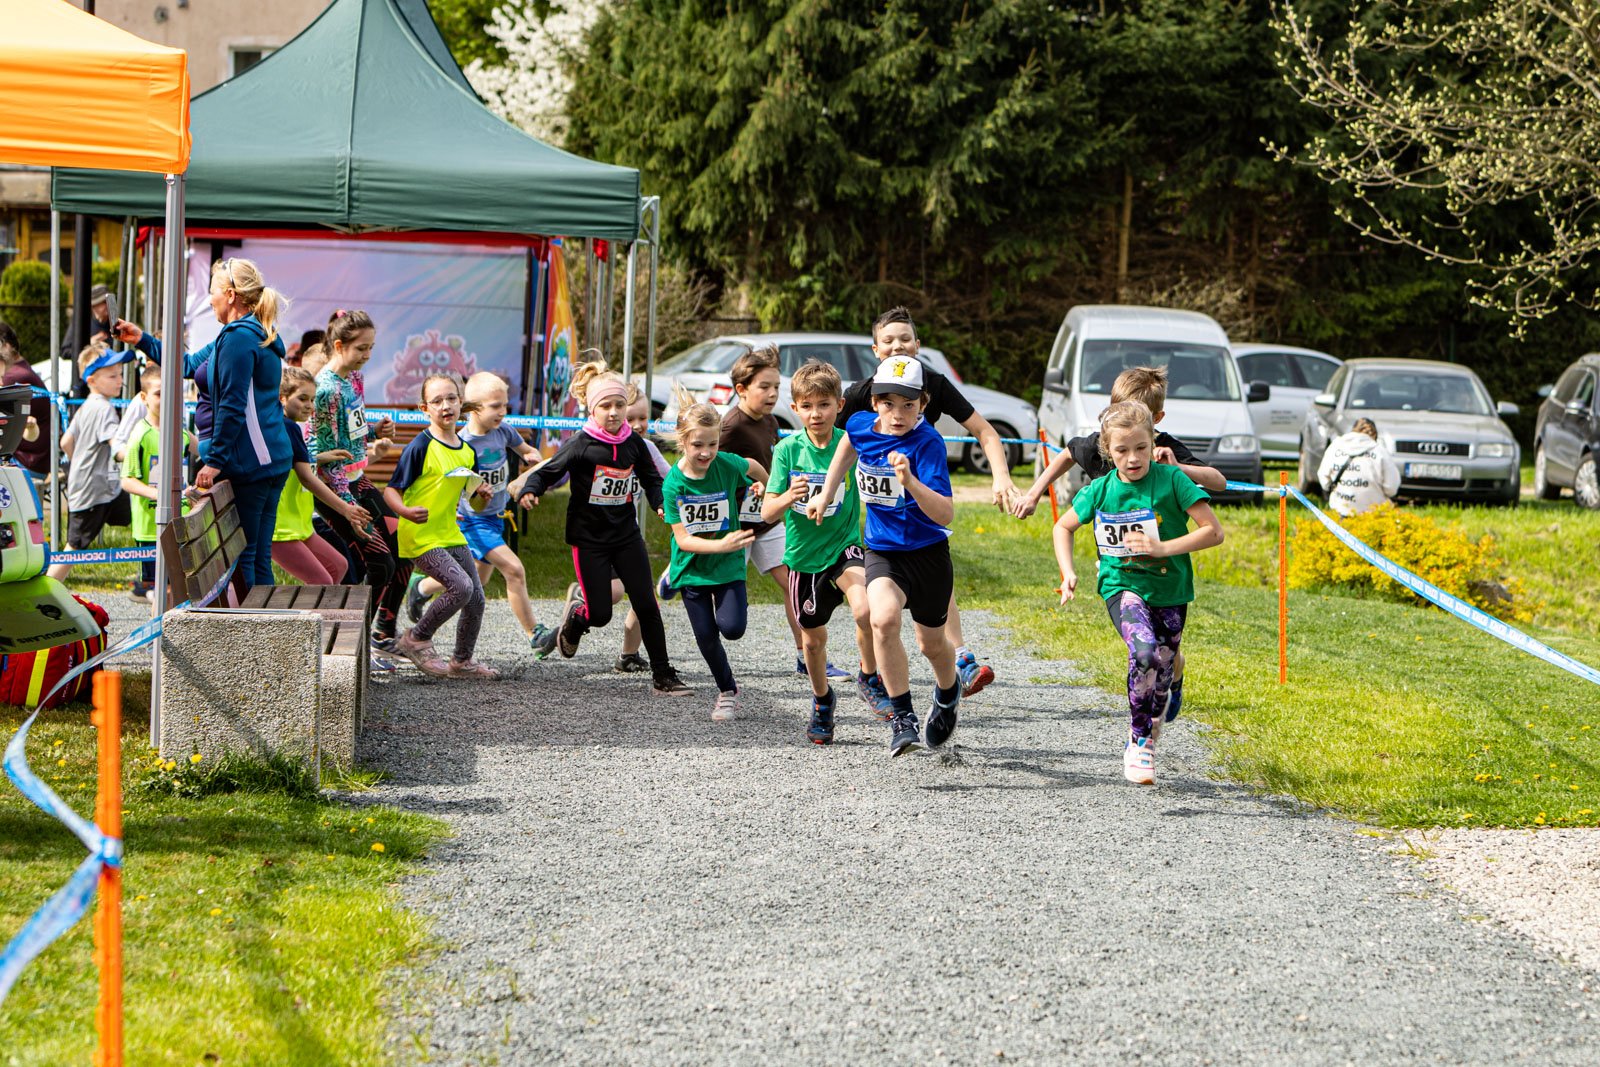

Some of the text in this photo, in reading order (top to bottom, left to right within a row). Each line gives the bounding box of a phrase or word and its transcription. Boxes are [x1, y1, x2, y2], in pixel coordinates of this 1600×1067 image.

[480, 466, 505, 486] 360
[859, 470, 892, 496] 334
[685, 502, 719, 524] 345
[50, 551, 106, 562] DECATHLON
